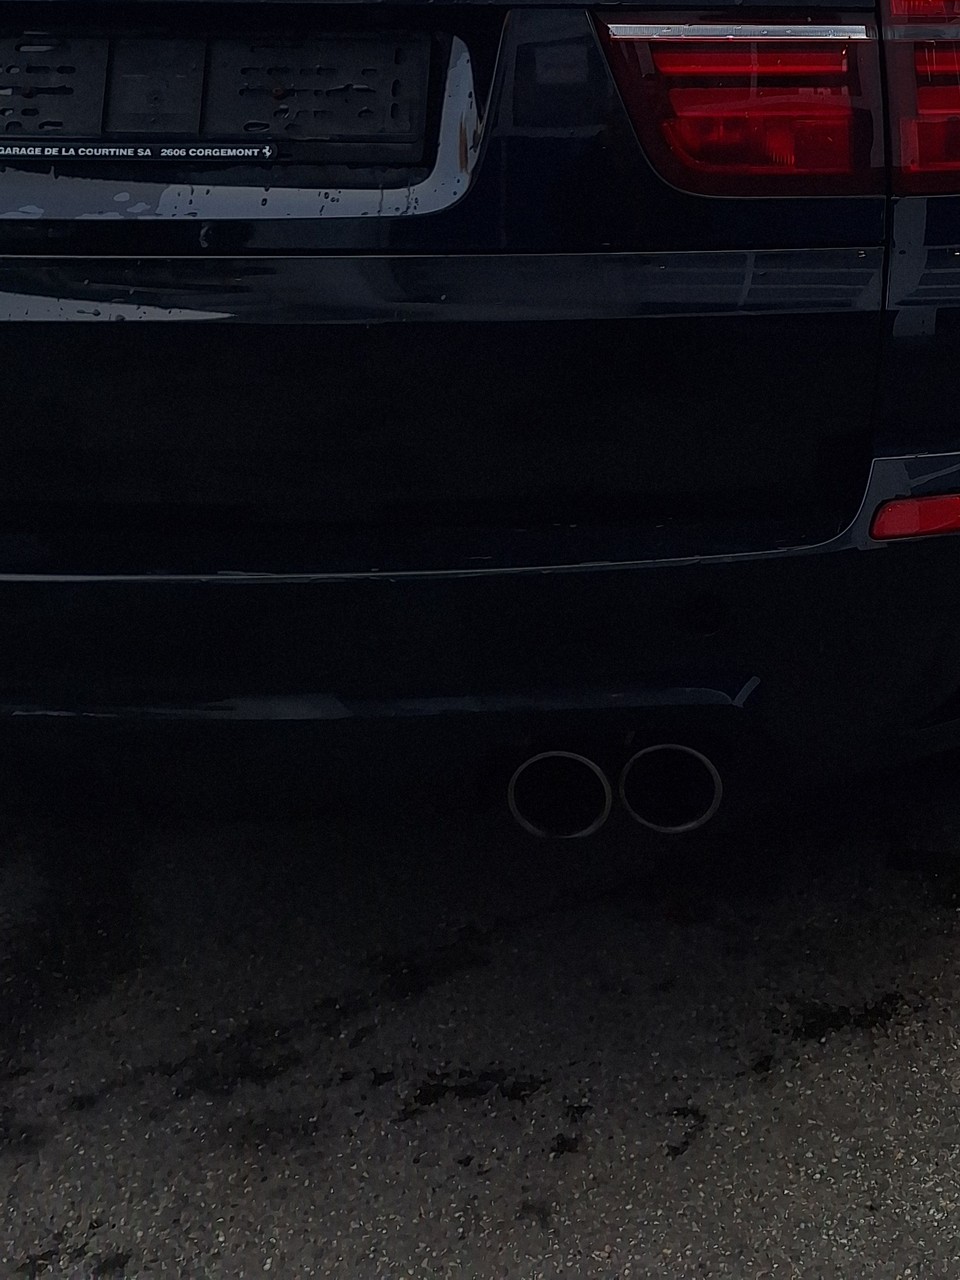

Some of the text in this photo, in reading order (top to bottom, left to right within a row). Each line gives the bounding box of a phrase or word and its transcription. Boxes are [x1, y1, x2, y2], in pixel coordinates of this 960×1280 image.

[45, 147, 59, 156] DE
[62, 148, 76, 156] LA
[78, 148, 134, 157] COURTINE
[137, 148, 152, 157] SA
[160, 149, 187, 157] 2606
[189, 148, 260, 157] CORGEMONT
